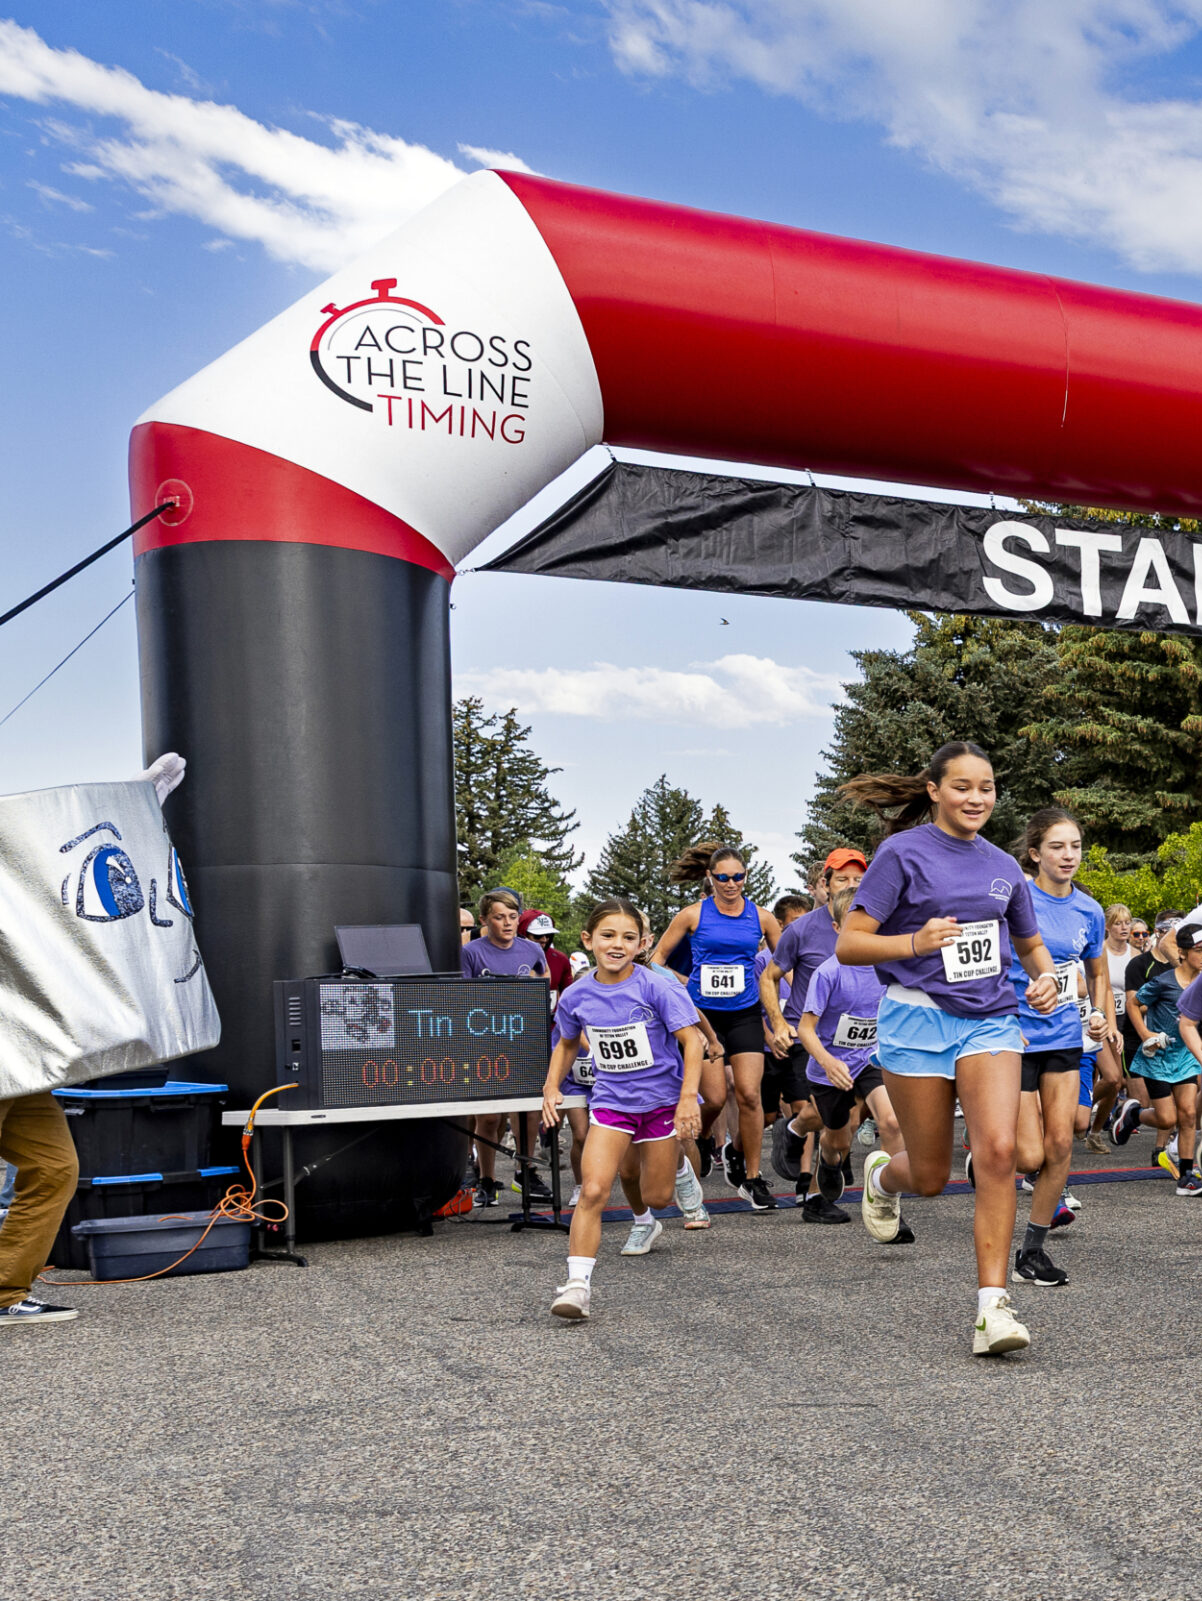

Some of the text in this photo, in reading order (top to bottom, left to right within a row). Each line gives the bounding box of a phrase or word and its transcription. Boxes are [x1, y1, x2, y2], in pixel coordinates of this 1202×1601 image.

[354, 324, 532, 372] ACROSS
[336, 355, 531, 408] THE LINE
[377, 394, 526, 444] TIMING
[956, 938, 992, 965] 592
[711, 975, 735, 988] 641
[953, 965, 998, 979] TIN CUP CHALLENGE
[407, 1008, 524, 1041] Tin Cup
[847, 1026, 878, 1041] 642
[599, 1039, 638, 1060] 698
[361, 1053, 511, 1089] 00:00:00
[579, 1066, 594, 1078] 64
[617, 1060, 649, 1070] CHALLENGE
